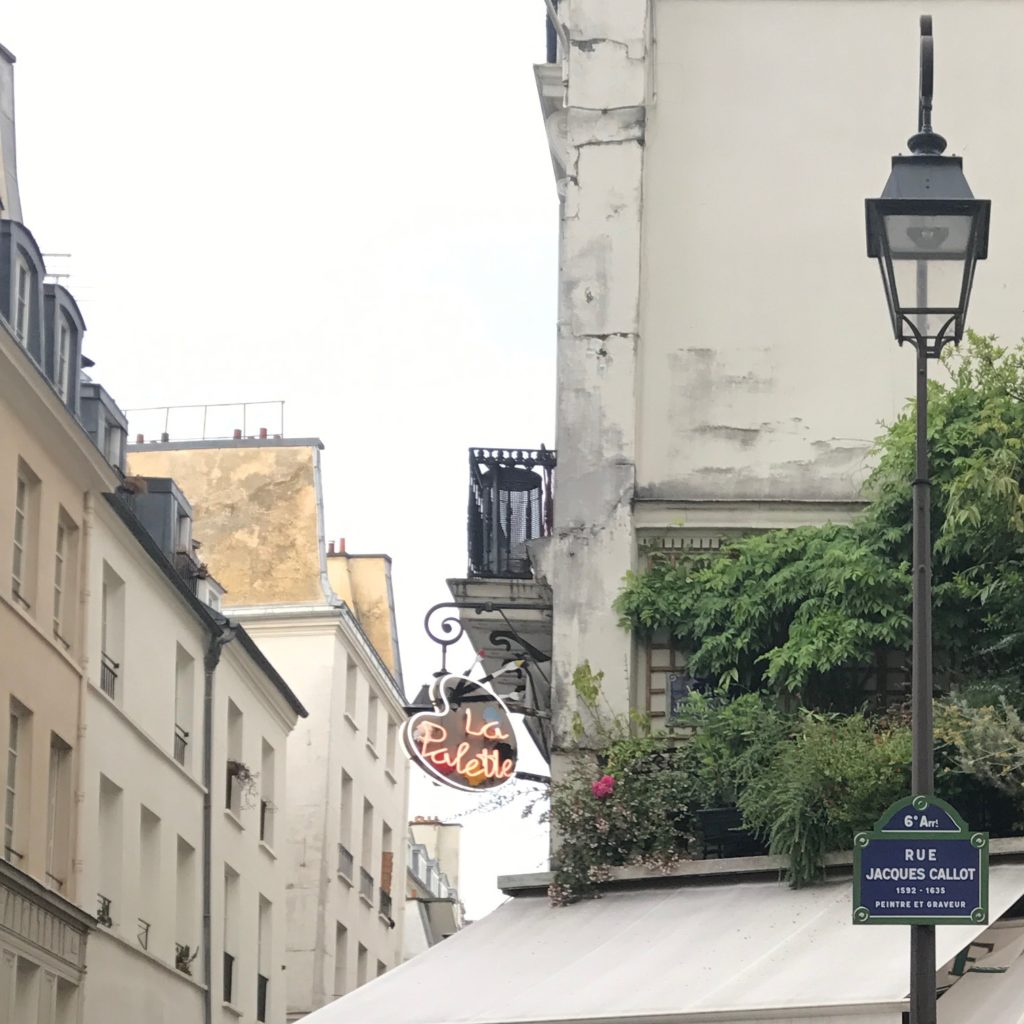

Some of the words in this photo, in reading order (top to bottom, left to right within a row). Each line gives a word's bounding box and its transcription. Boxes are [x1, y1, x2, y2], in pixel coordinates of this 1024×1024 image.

[465, 708, 509, 740] La
[420, 720, 513, 779] Palette
[905, 848, 937, 861] RUE
[865, 867, 926, 881] JACQUES
[929, 867, 976, 880] CALLOT
